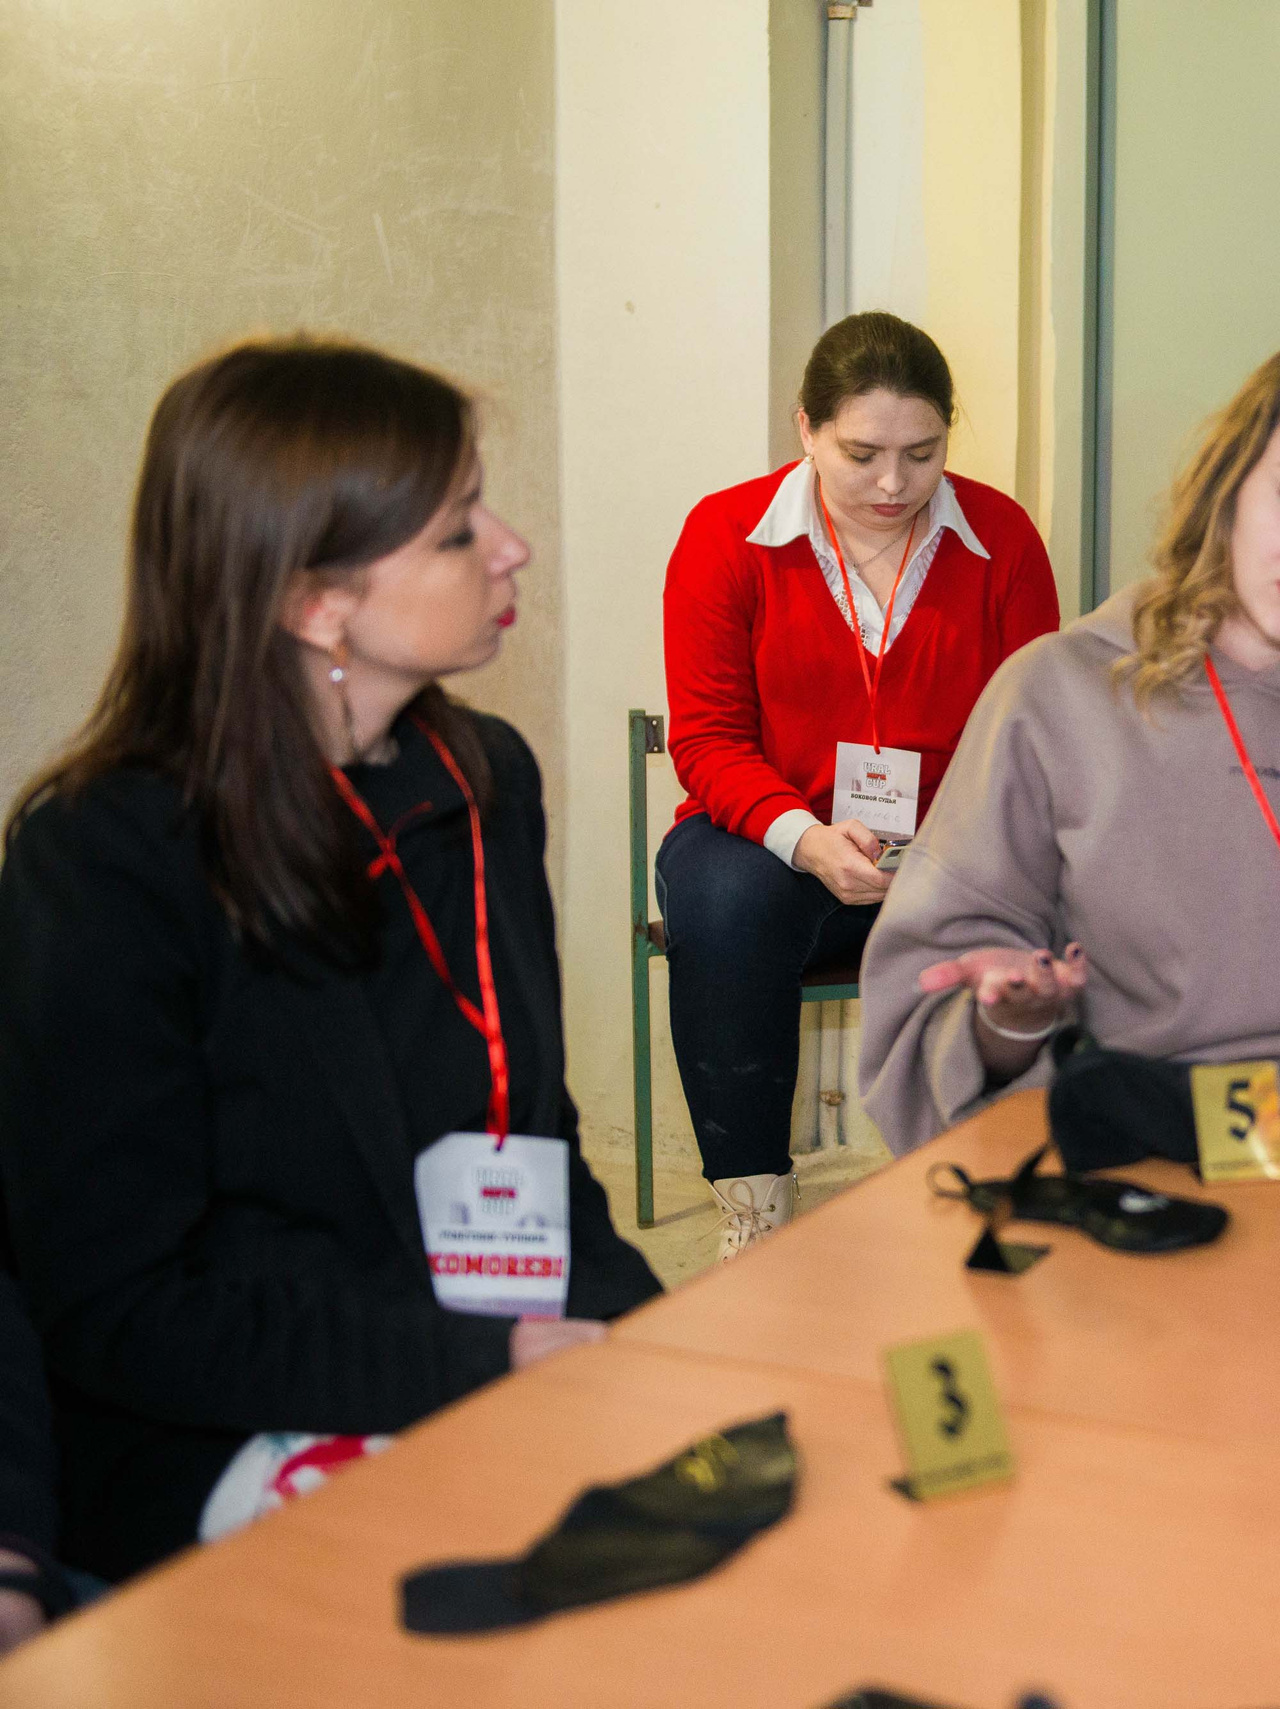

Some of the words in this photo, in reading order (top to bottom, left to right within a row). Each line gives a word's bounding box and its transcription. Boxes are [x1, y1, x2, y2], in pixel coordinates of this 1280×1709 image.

[864, 762, 891, 774] URAL
[865, 779, 886, 789] CUP
[1227, 1079, 1257, 1140] 5
[929, 1357, 970, 1438] 3
